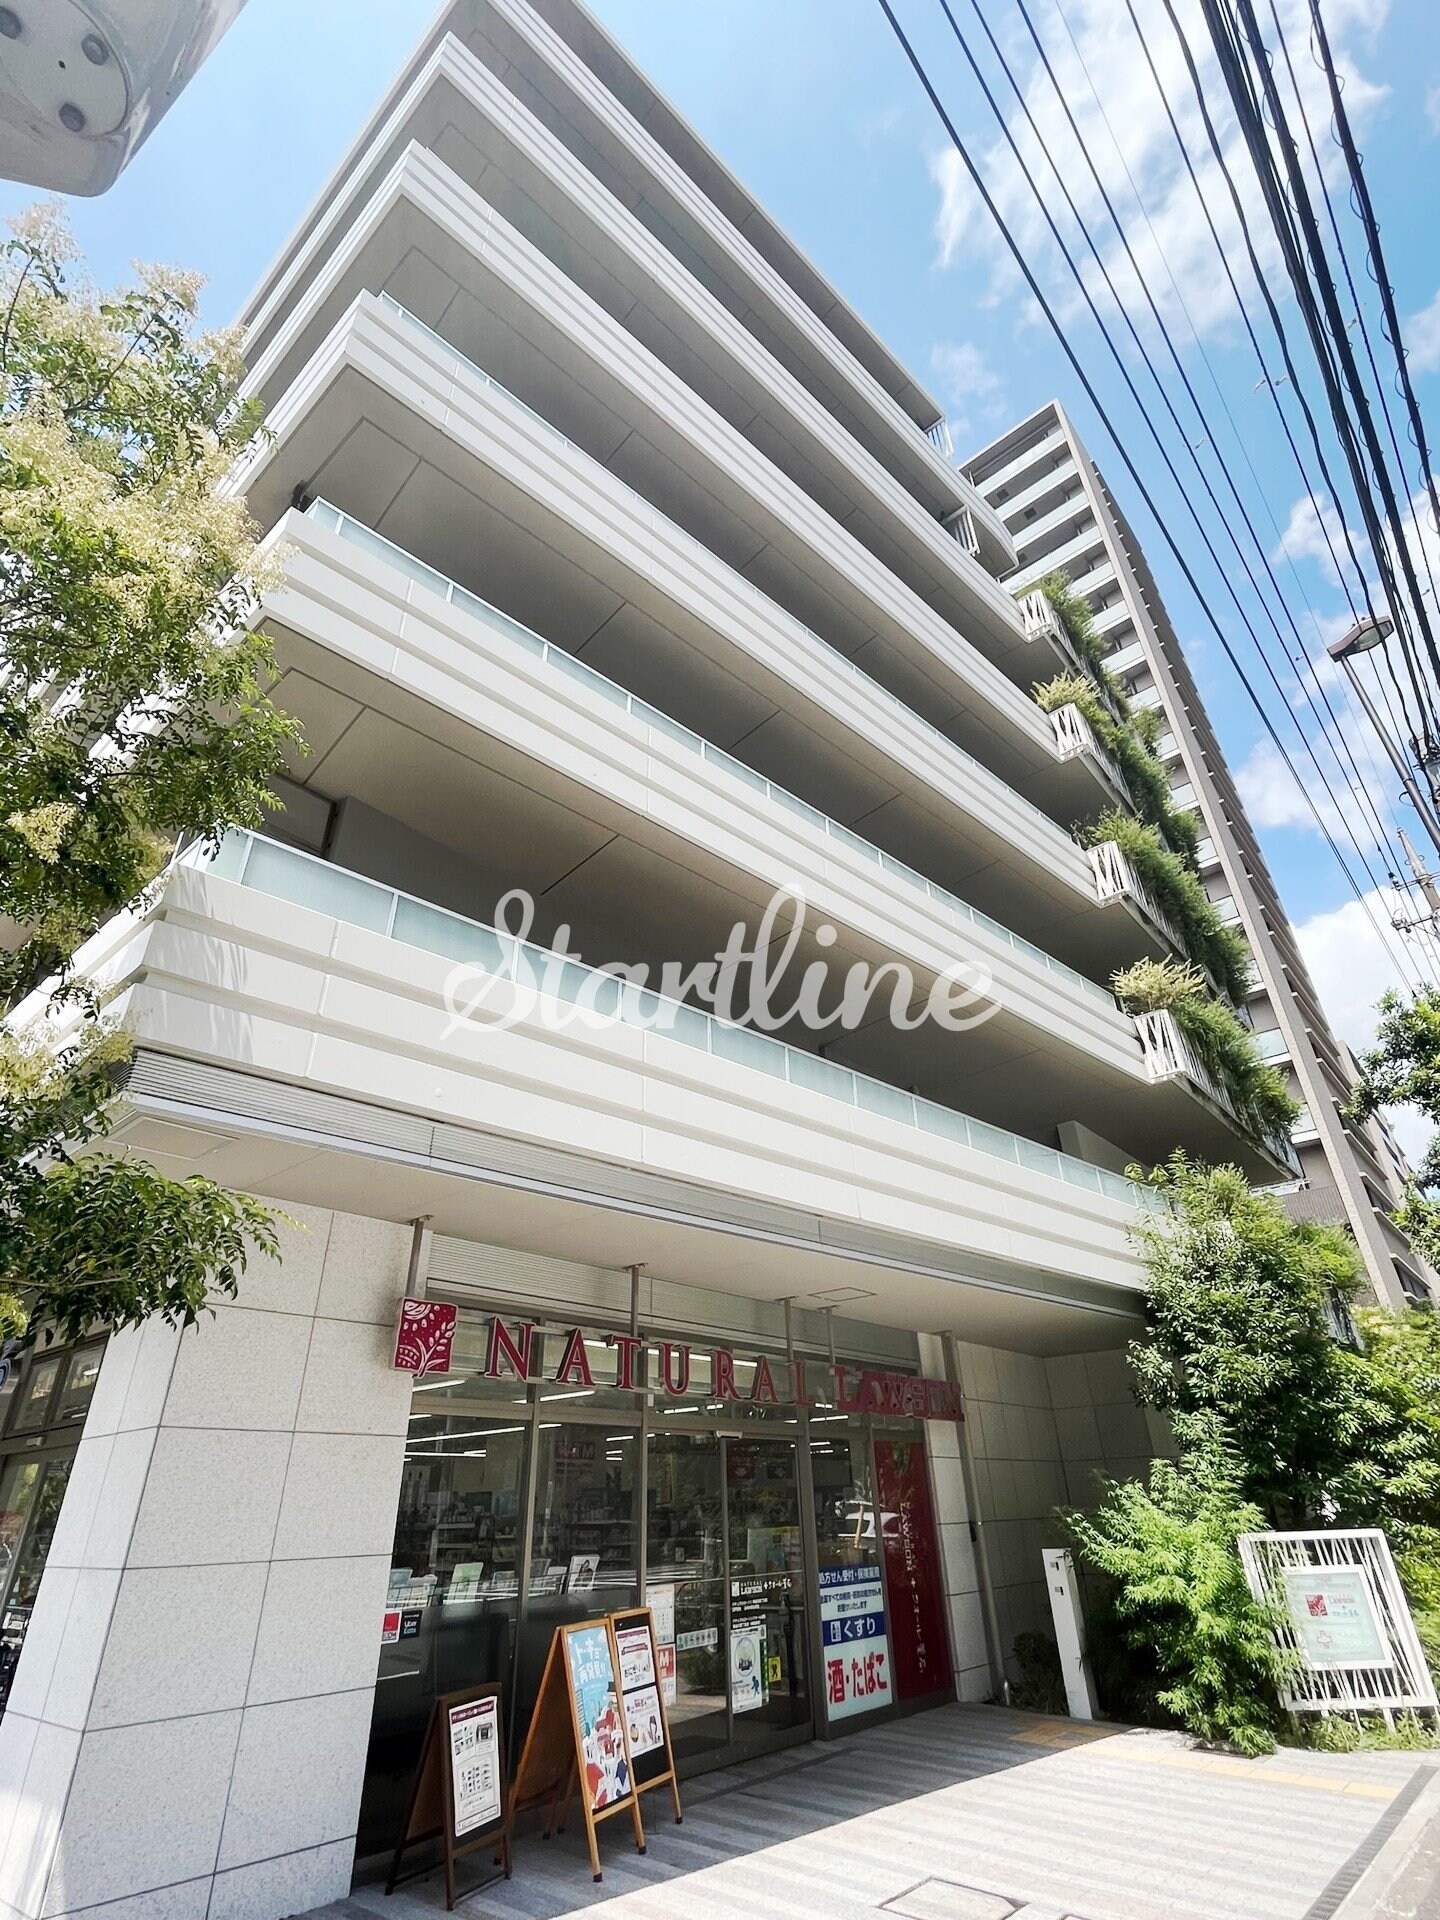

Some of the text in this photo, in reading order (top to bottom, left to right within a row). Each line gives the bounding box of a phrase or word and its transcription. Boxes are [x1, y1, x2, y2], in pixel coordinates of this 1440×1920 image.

[484, 1316, 815, 1409] NATURAL
[404, 1620, 417, 1628] Uber
[843, 1617, 876, 1638] くすり
[827, 1651, 887, 1704] 酒・たばこ
